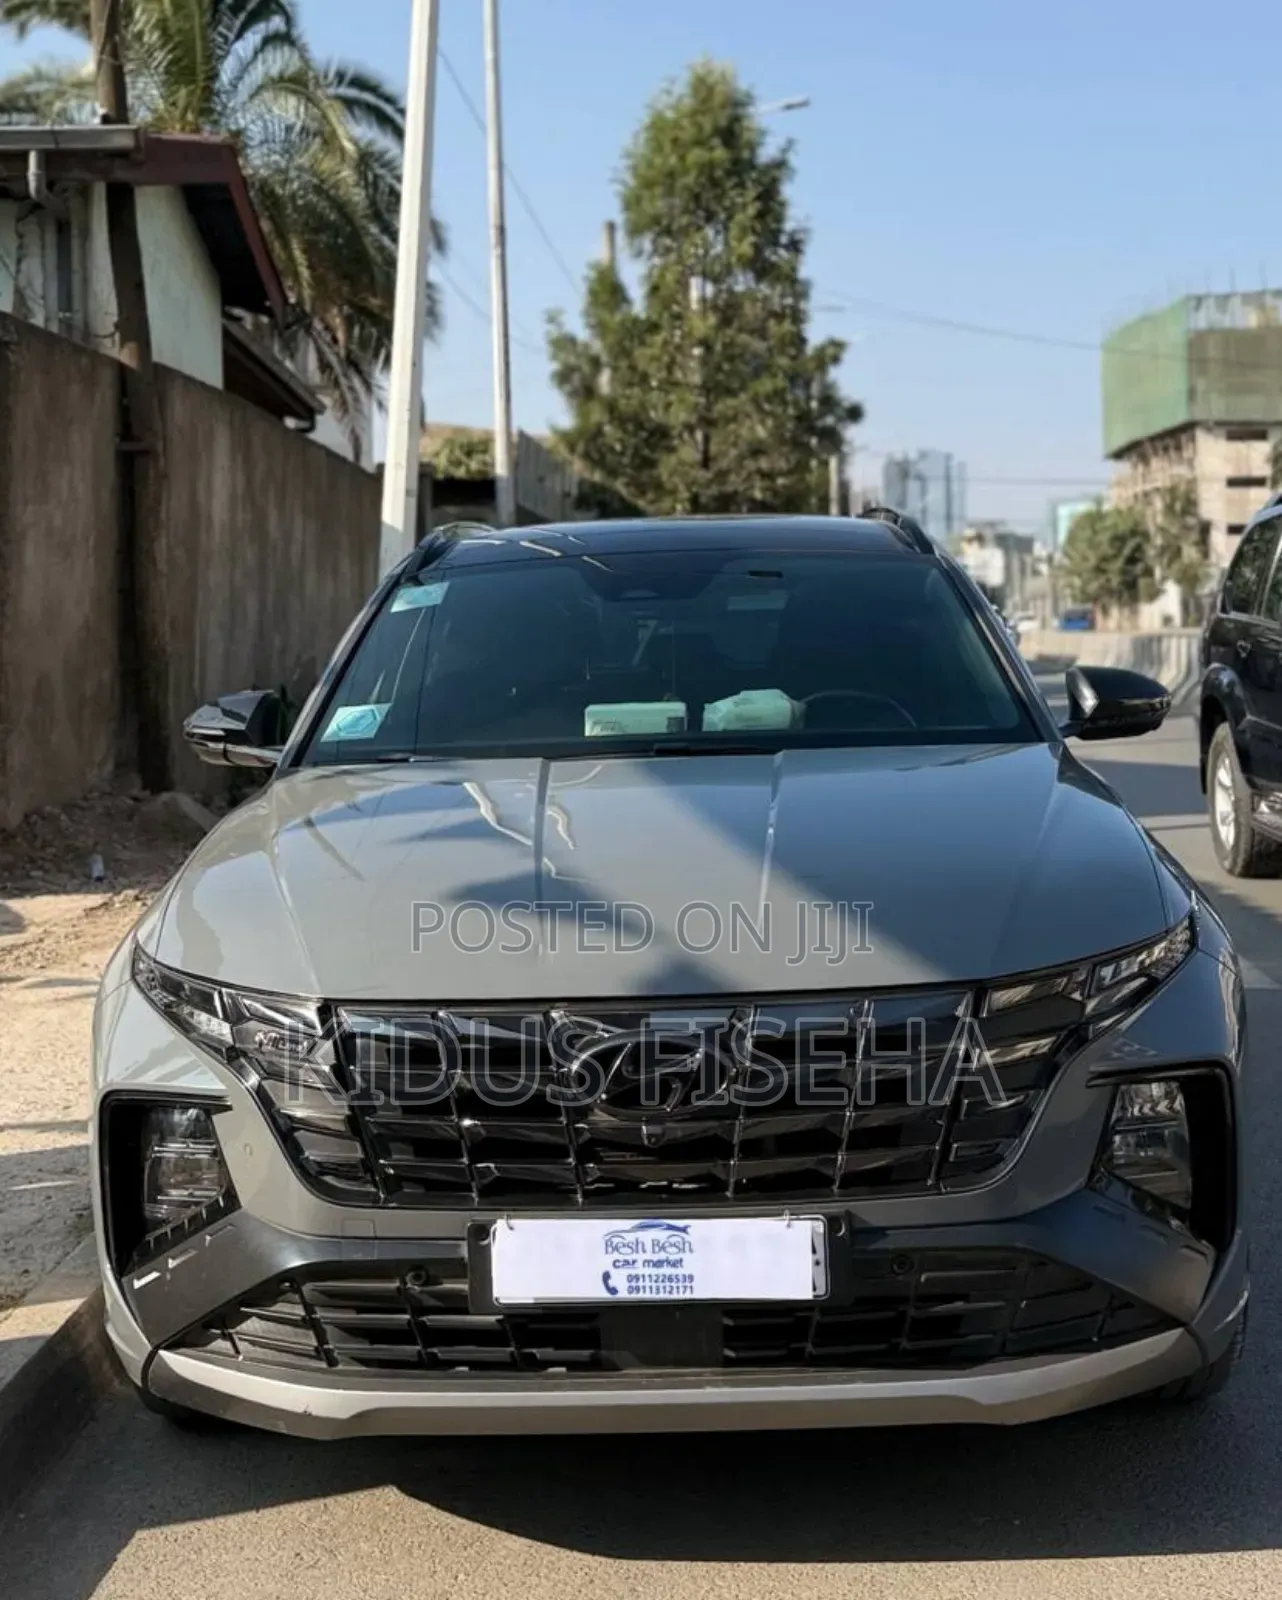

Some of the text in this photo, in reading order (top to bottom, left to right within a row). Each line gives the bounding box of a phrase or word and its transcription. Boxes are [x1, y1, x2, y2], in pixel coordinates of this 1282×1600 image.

[604, 1236, 695, 1255] Besh Besh
[612, 1257, 684, 1269] car market
[626, 1273, 695, 1284] 0911226539
